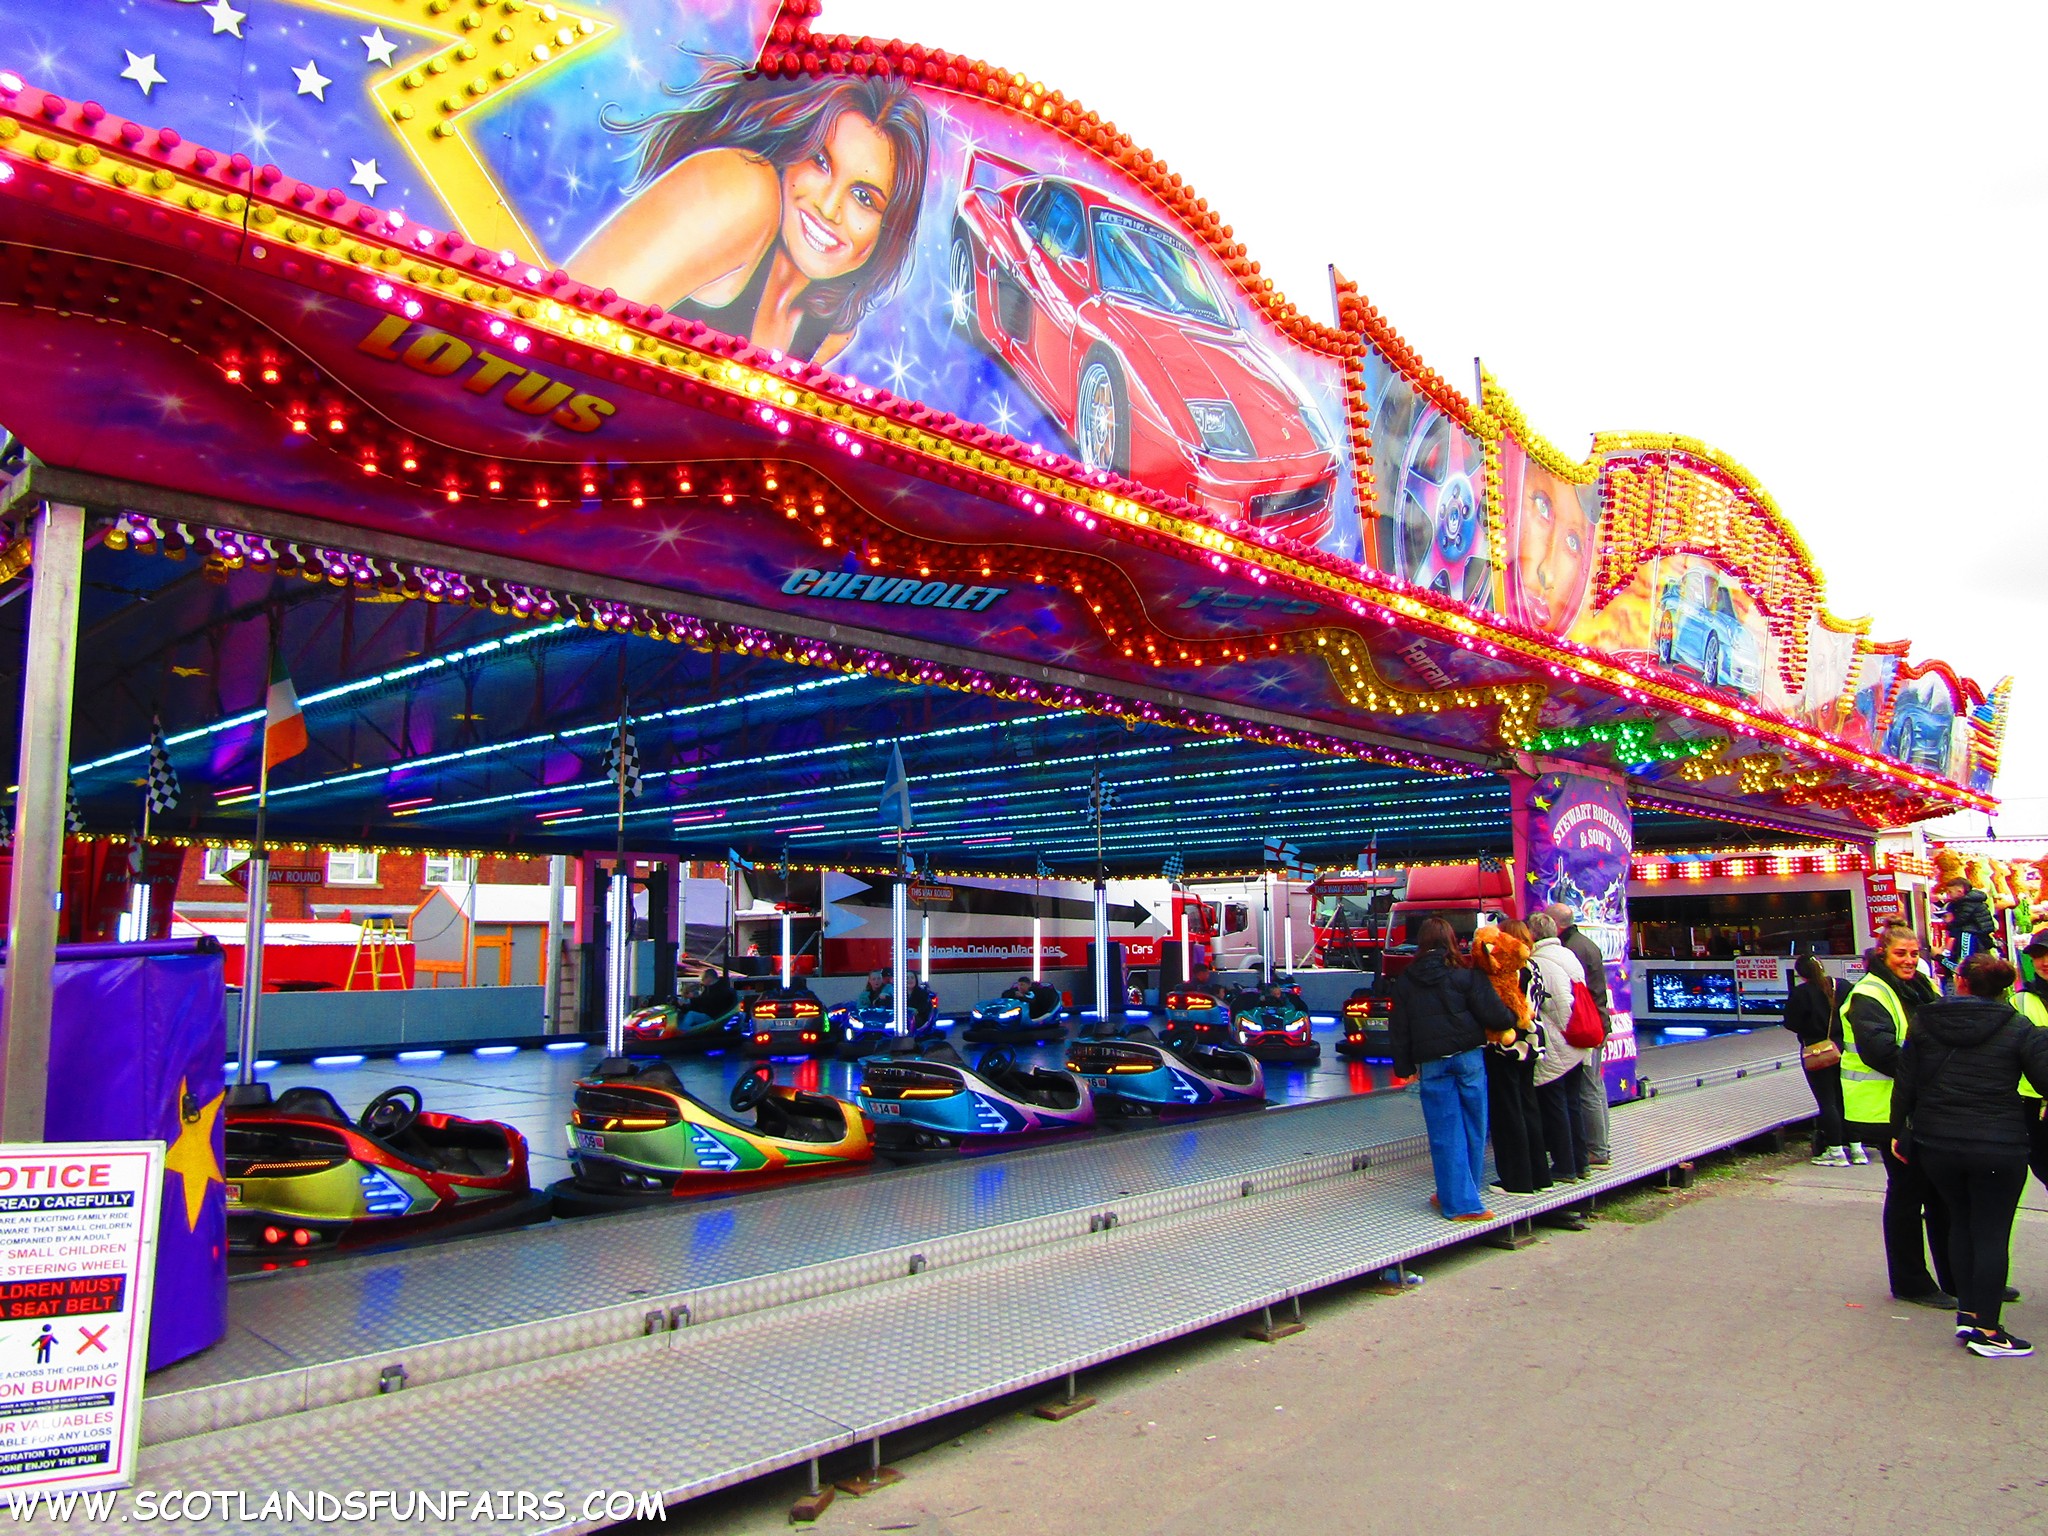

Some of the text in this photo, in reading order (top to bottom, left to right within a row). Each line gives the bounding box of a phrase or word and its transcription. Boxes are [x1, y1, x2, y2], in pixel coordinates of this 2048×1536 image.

[358, 314, 616, 432] LOTUS
[781, 568, 1009, 612] CHEVROLET
[1395, 637, 1460, 690] Ferrari
[1553, 803, 1633, 853] STEWART ROBINSON
[286, 871, 321, 883] ROUND
[1873, 884, 1887, 892] BUY
[1867, 894, 1897, 903] DODGEM
[1869, 904, 1898, 913] TOKENS
[1131, 943, 1154, 955] Cars
[1736, 969, 1778, 979] HERE
[1608, 1039, 1624, 1060] PAY
[0, 1193, 131, 1211] READ CAREFULLY
[19, 1216, 31, 1224] AN
[34, 1214, 76, 1223] EXCITING
[77, 1213, 107, 1221] FAMILY
[109, 1212, 129, 1220] RIDE
[33, 1225, 55, 1233] THAT
[57, 1223, 87, 1232] SMALL
[89, 1221, 133, 1231] CHILDREN
[55, 1235, 67, 1243] BY
[68, 1234, 81, 1242] AN
[83, 1233, 111, 1241] ADULT
[8, 1247, 55, 1259] SMALL
[59, 1243, 127, 1257] CHILDREN
[8, 1262, 77, 1276] STEERING
[81, 1259, 128, 1271] WHEEL
[69, 1277, 123, 1294] MUST
[11, 1299, 62, 1318] SEAT
[65, 1295, 115, 1313] BELT
[6, 1369, 44, 1379] ACROSS
[47, 1367, 65, 1375] THE
[66, 1364, 99, 1374] CHILDS
[101, 1361, 119, 1370] LAP
[32, 1373, 117, 1395] BUMPING
[21, 1411, 114, 1432] VALUABLES
[57, 1430, 81, 1441] ANY
[84, 1427, 112, 1438] LOSS
[47, 1447, 60, 1457] TO
[62, 1442, 107, 1455] YOUNGER
[25, 1458, 57, 1471] ENJOY
[59, 1456, 77, 1467] THE
[78, 1454, 97, 1464] FUN
